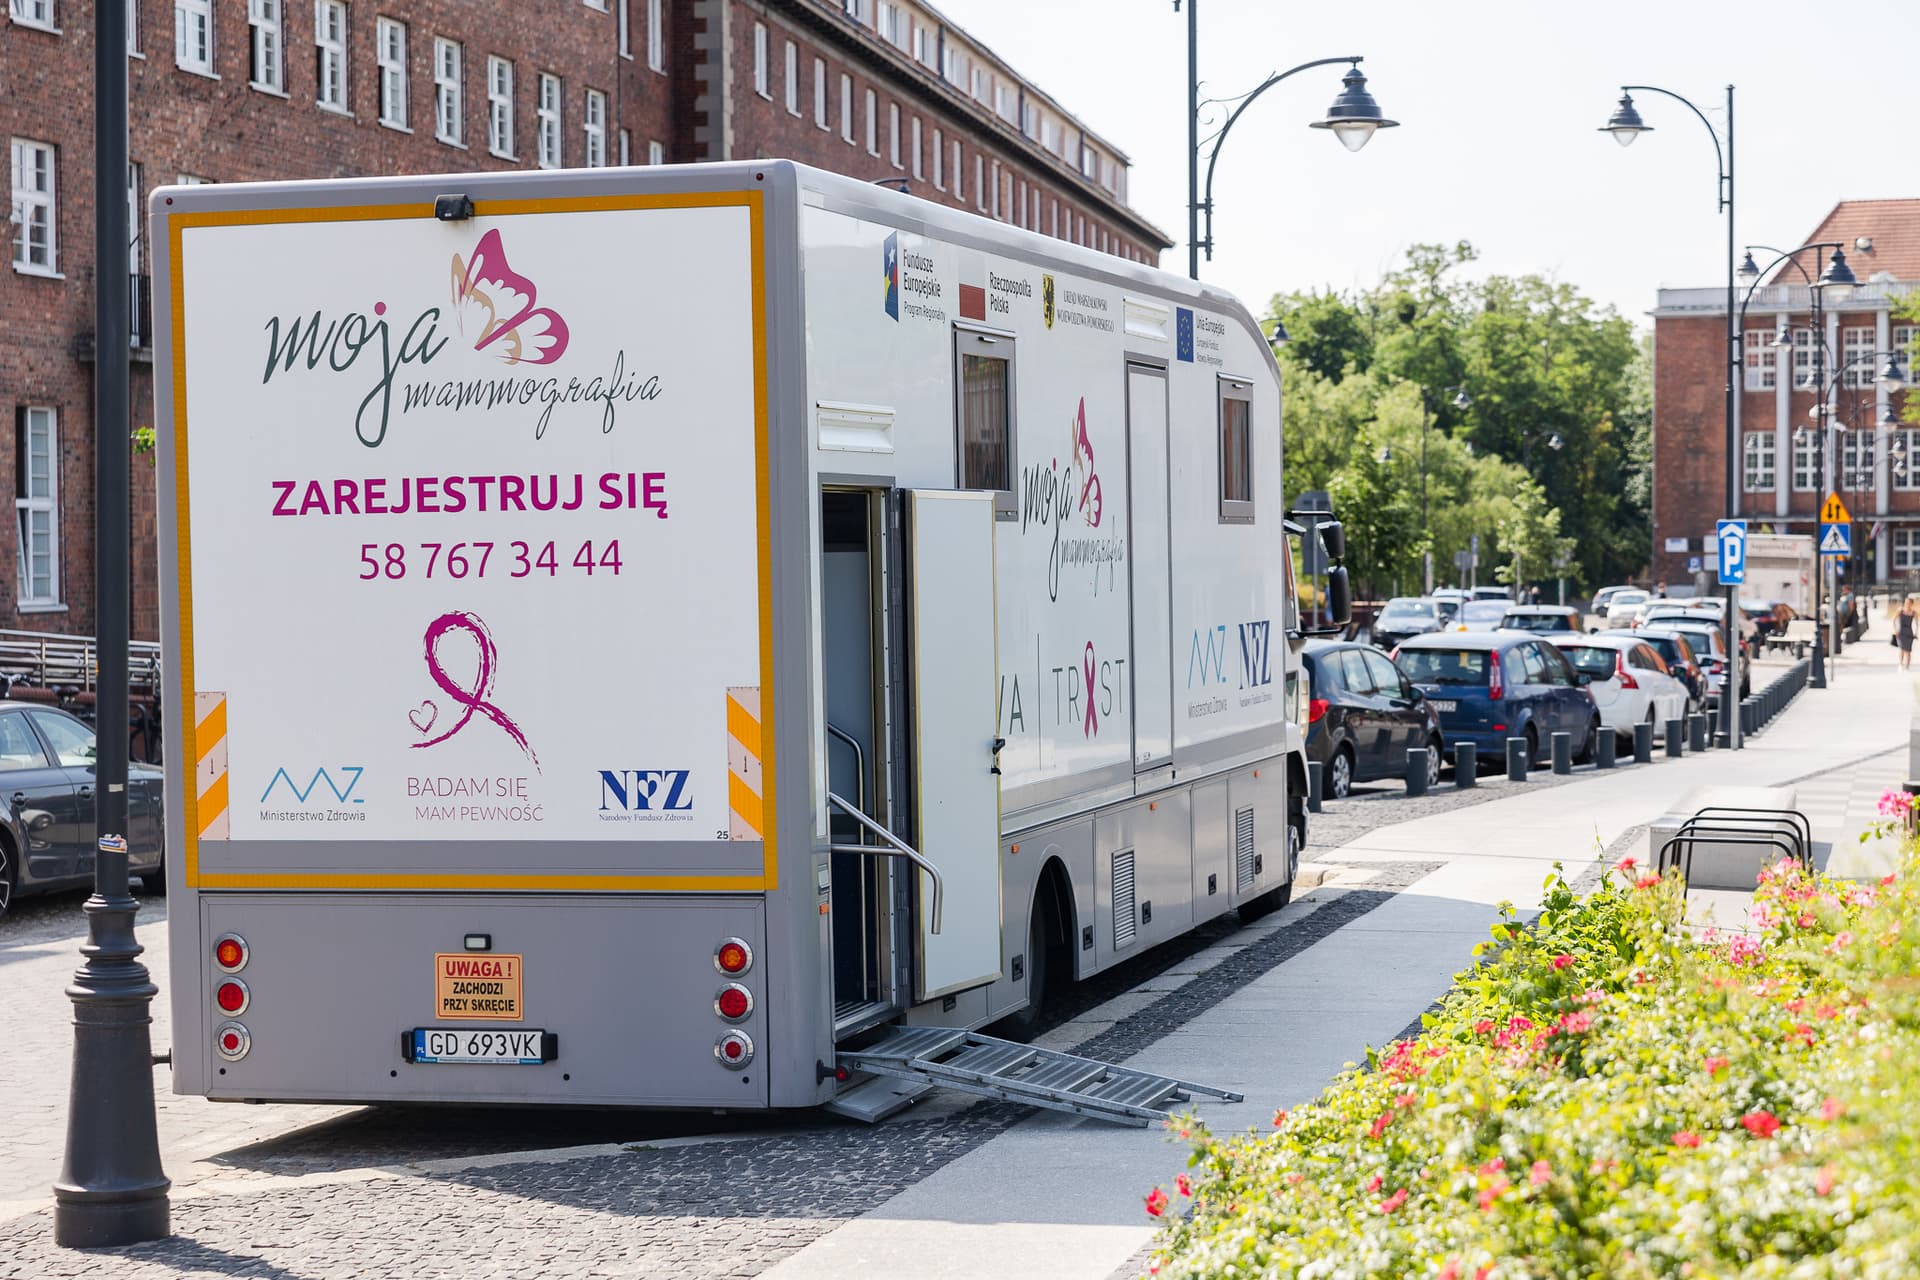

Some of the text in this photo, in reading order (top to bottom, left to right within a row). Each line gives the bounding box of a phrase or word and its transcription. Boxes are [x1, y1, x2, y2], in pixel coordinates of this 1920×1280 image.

[903, 248, 934, 273] Fundusze
[903, 272, 941, 299] Europejskie
[989, 271, 1032, 298] Rzeczpospolita
[990, 293, 1010, 314] Polska
[263, 301, 449, 448] moja
[403, 350, 661, 440] mammografia
[271, 472, 668, 519] ZAREJESTRUJ SIĘ
[1022, 457, 1073, 603] moja
[359, 540, 623, 579] 58 767 34 44
[1723, 536, 1742, 577] P
[407, 776, 528, 801] BADAM SIĘ
[597, 770, 694, 810] NFZ
[260, 809, 365, 822] Ministerstwo Zdrowia
[415, 803, 544, 822] MAM PEWNOŚĆ
[598, 813, 694, 824] Narodowy Fundusz Zdrowia
[716, 831, 729, 840] 25
[445, 961, 503, 977] UWAGA
[453, 982, 503, 995] ZACHODZI
[443, 998, 515, 1014] PRZY SKRĘCIE
[416, 1046, 425, 1054] PL
[430, 1033, 537, 1057] GD 693VK
